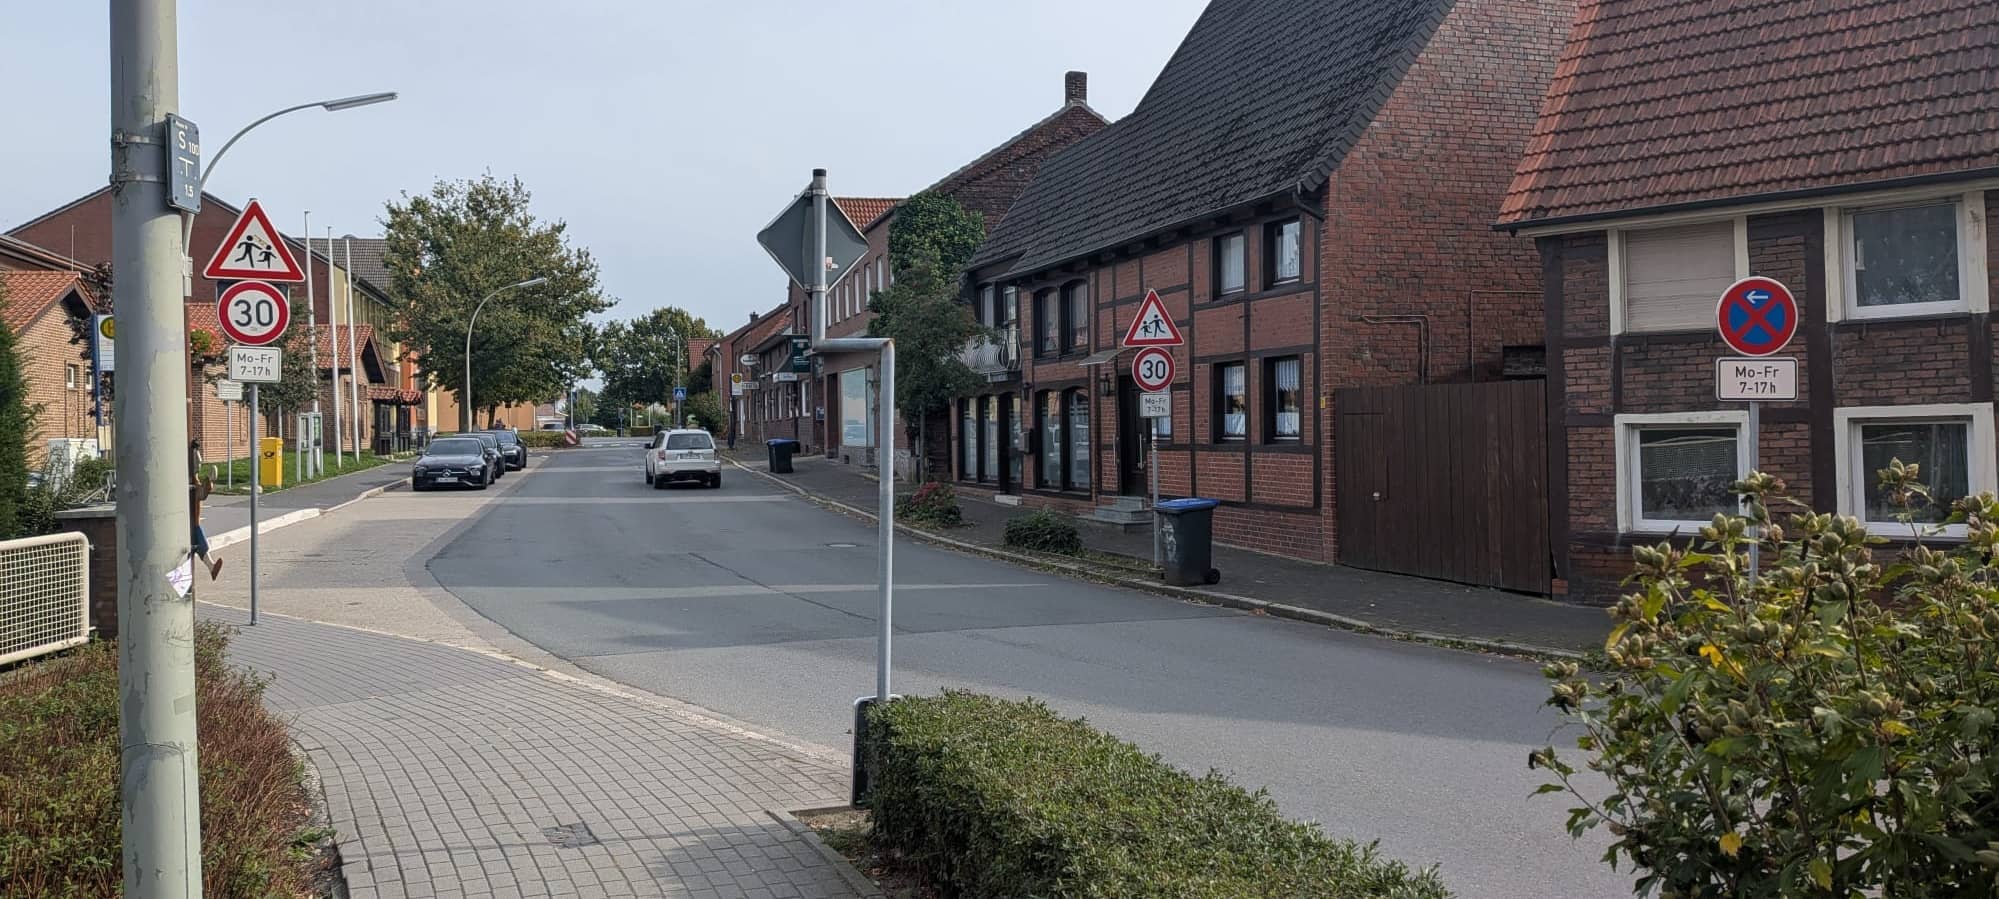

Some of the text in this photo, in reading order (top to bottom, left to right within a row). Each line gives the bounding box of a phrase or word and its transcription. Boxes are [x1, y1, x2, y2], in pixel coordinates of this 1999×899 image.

[178, 131, 186, 150] S
[234, 299, 274, 327] 30
[236, 352, 273, 364] Mo-Fr
[1142, 360, 1166, 379] 30
[1735, 365, 1779, 378] Mo-Fr
